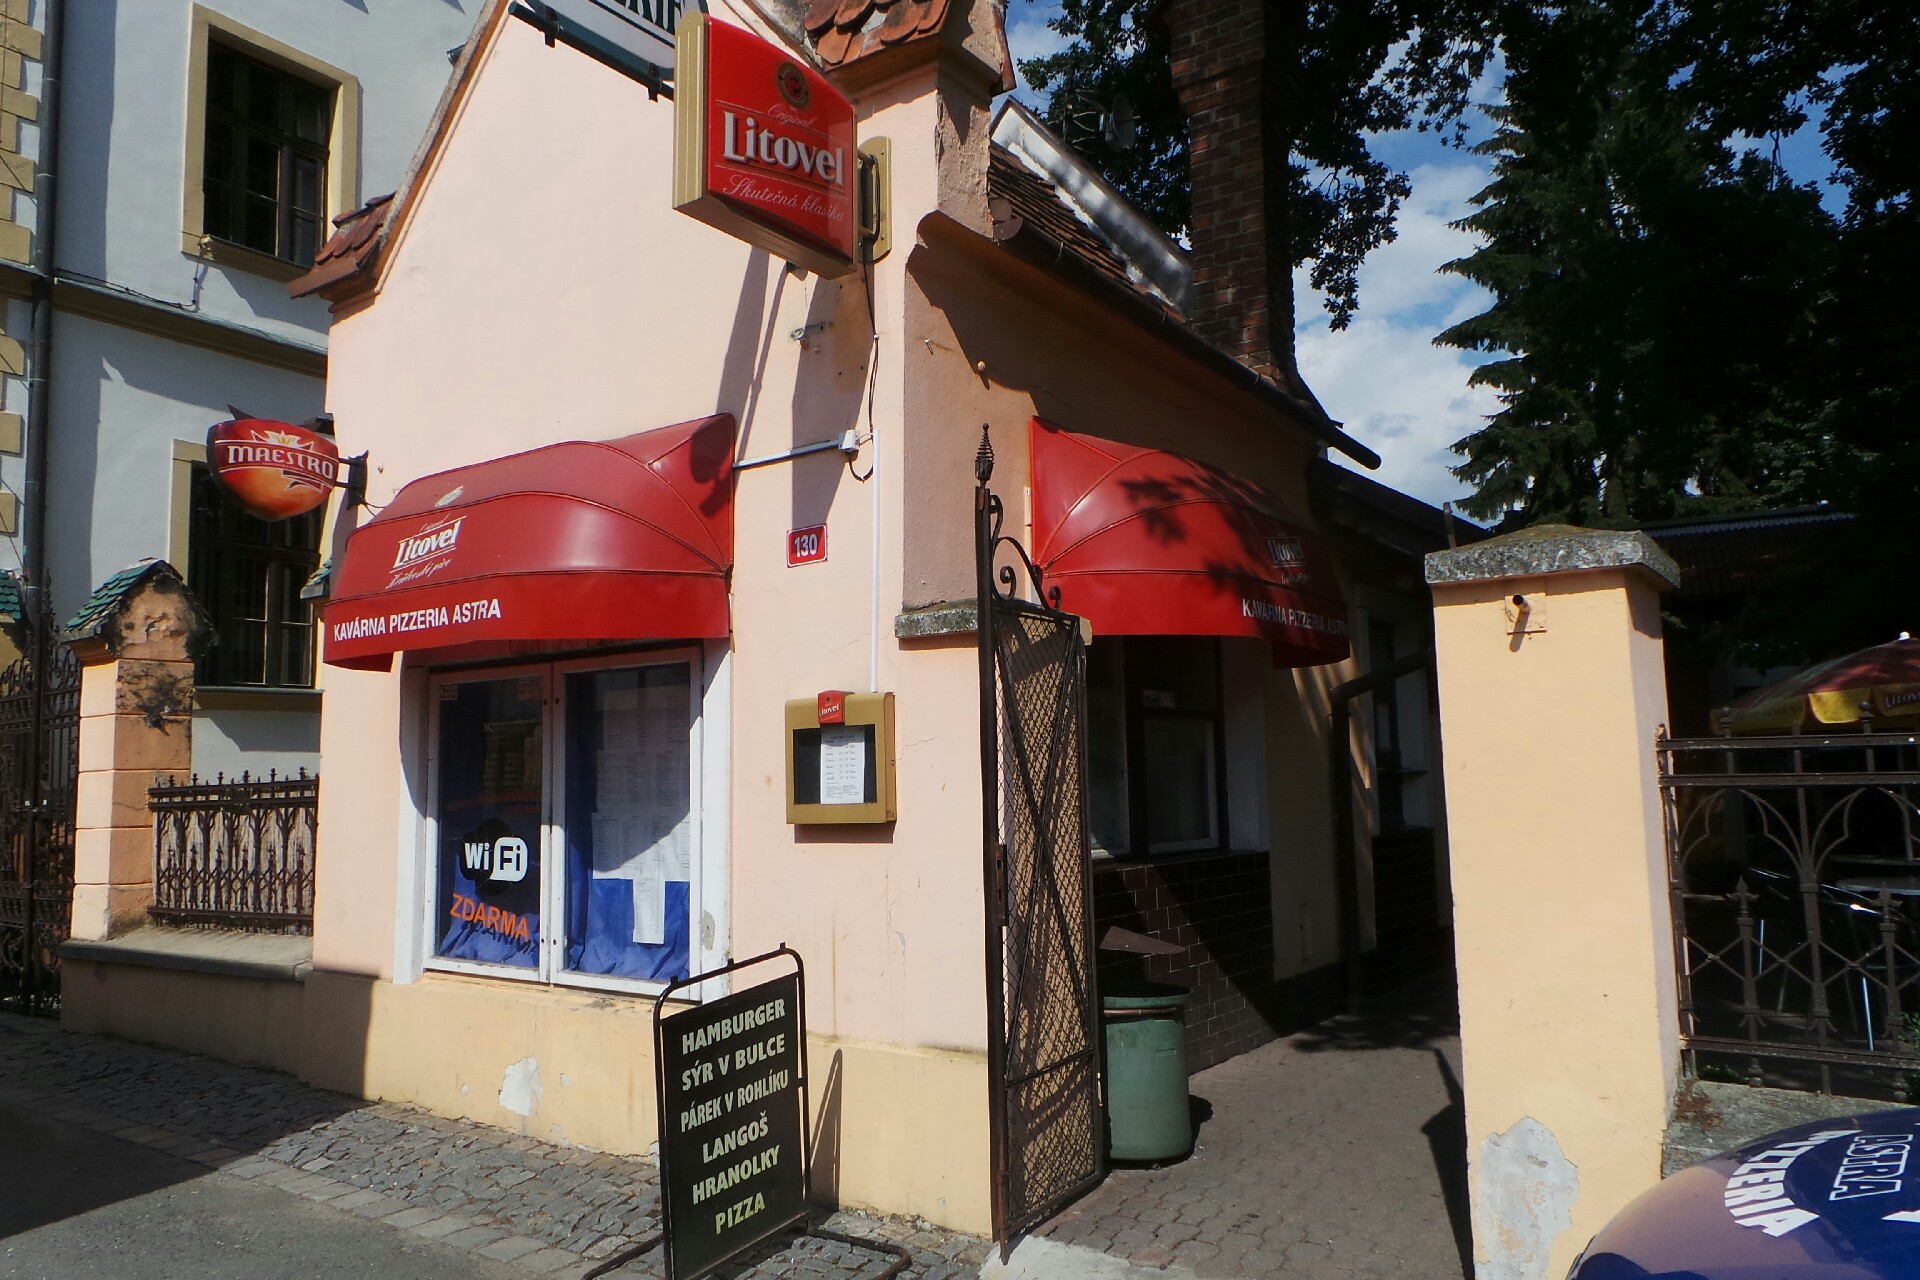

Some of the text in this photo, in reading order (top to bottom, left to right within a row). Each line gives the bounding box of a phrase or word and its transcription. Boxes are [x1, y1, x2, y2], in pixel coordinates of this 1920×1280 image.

[723, 111, 844, 186] Litovel
[723, 174, 799, 209] Skutečná
[227, 445, 334, 480] MAESTRO
[393, 519, 461, 569] Litovel
[795, 533, 818, 558] 130
[334, 598, 502, 642] KAVÁRNA PIZZERIA ASTRA
[1242, 598, 1287, 625] KAVÁRNA
[1289, 608, 1326, 632] PIZZERIA
[450, 893, 530, 942] ZDARMA
[682, 998, 786, 1055] HAMBURGER
[682, 1033, 785, 1091] SÝR V BULCE
[681, 1069, 789, 1133] PÁREK V ROHLÍKU
[702, 1110, 769, 1164] LANGOŠ
[692, 1144, 780, 1205] HRANOLKY
[1829, 1134, 1914, 1201] ASTRA
[715, 1192, 766, 1235] PIZZA
